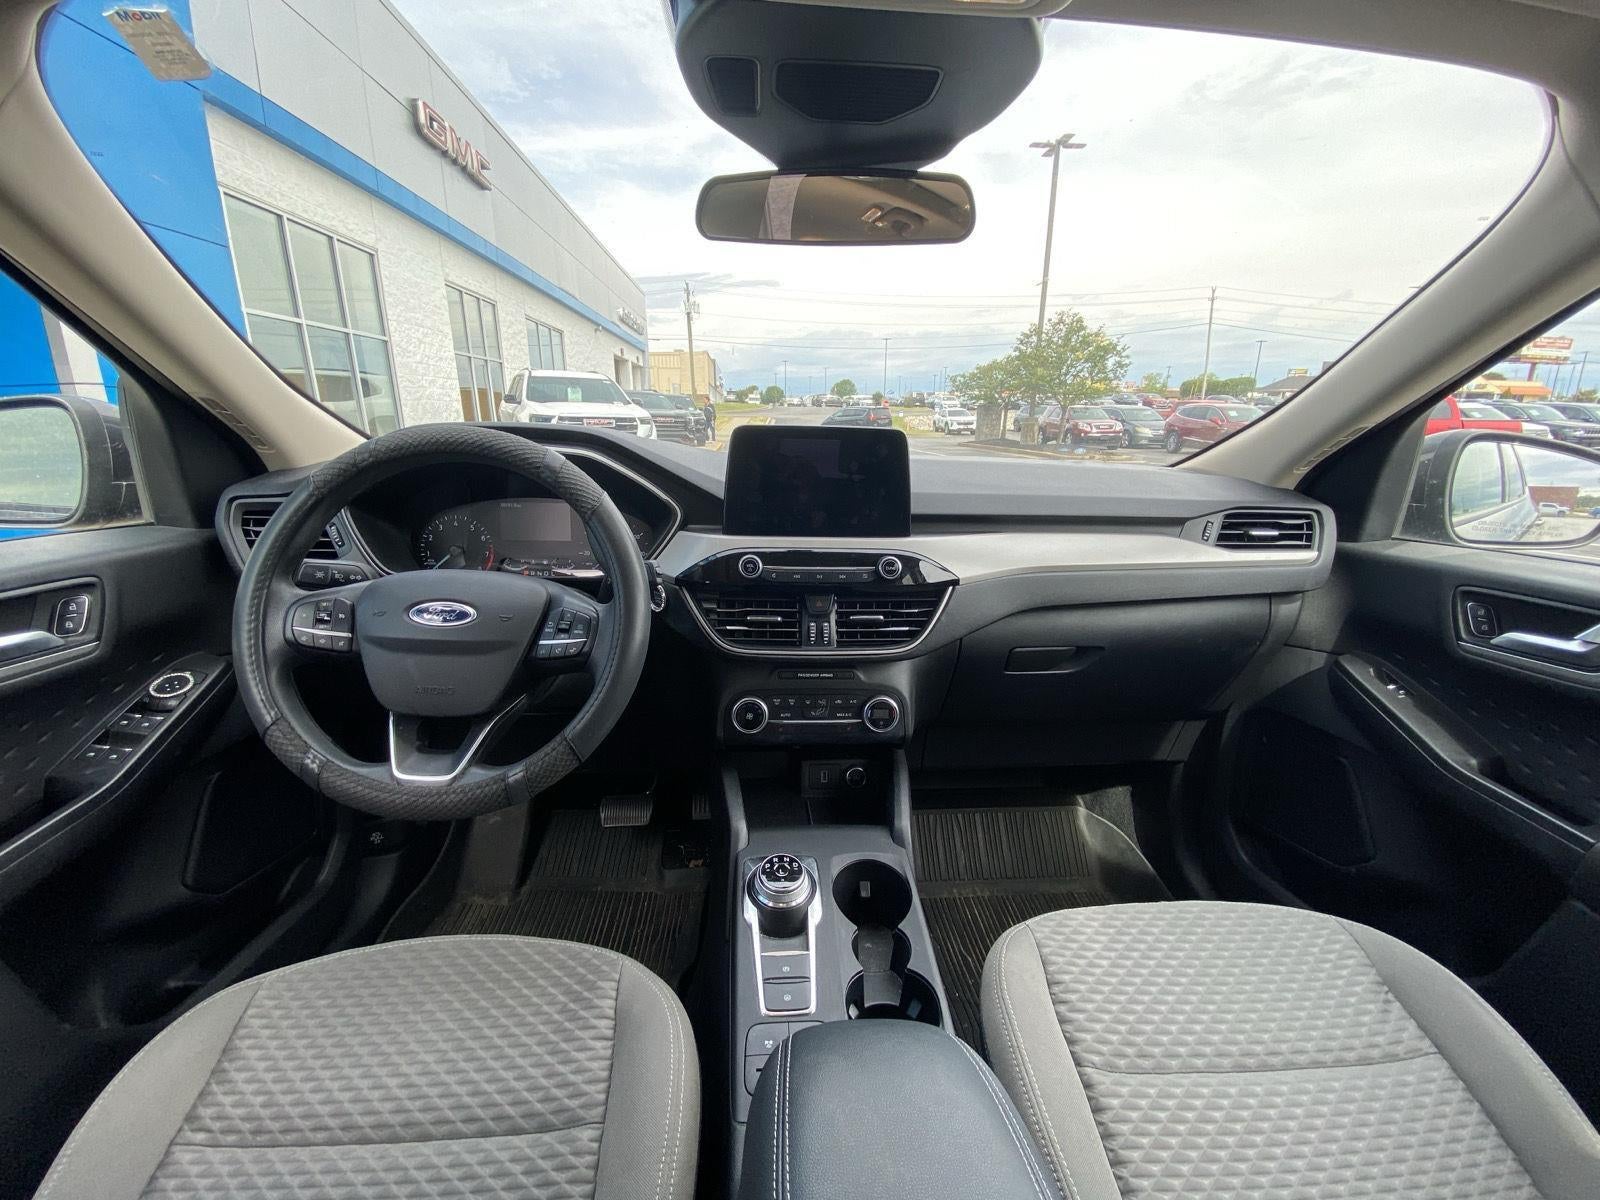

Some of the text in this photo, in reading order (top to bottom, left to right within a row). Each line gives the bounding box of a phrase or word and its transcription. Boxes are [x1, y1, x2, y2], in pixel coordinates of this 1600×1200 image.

[115, 10, 162, 22] Mobil
[411, 98, 492, 191] GMC
[423, 606, 460, 622] Ford
